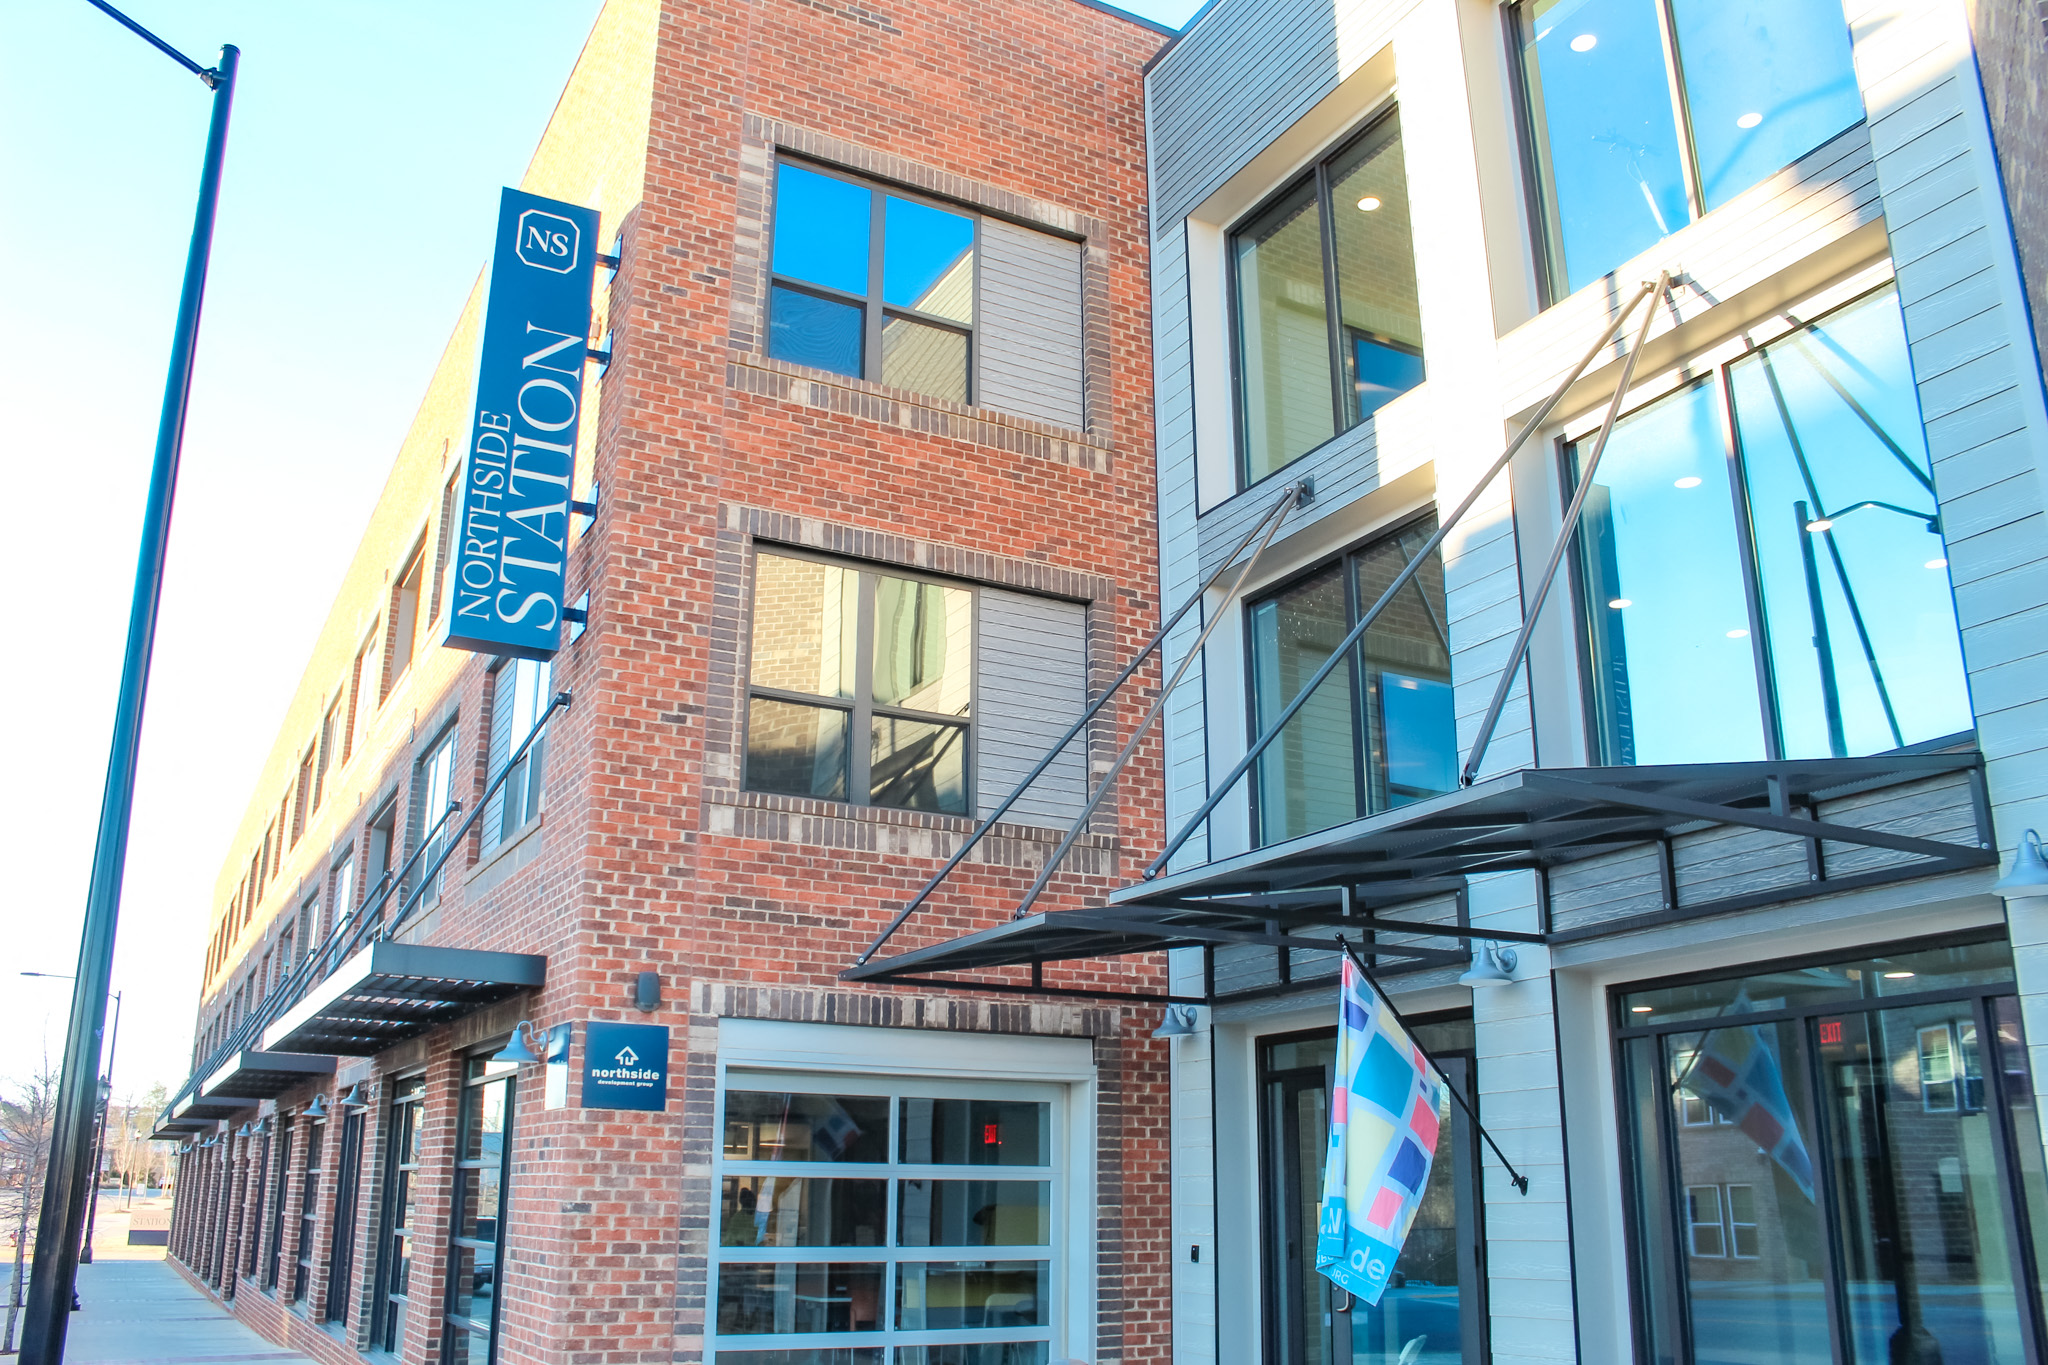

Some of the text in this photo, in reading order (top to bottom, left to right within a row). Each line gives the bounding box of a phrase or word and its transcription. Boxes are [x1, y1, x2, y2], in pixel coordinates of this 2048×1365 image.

[525, 225, 569, 257] NS
[495, 320, 584, 632] STATION
[457, 410, 511, 621] NORTHSIDE
[1819, 1021, 1842, 1043] EXIT
[591, 1067, 660, 1080] northside
